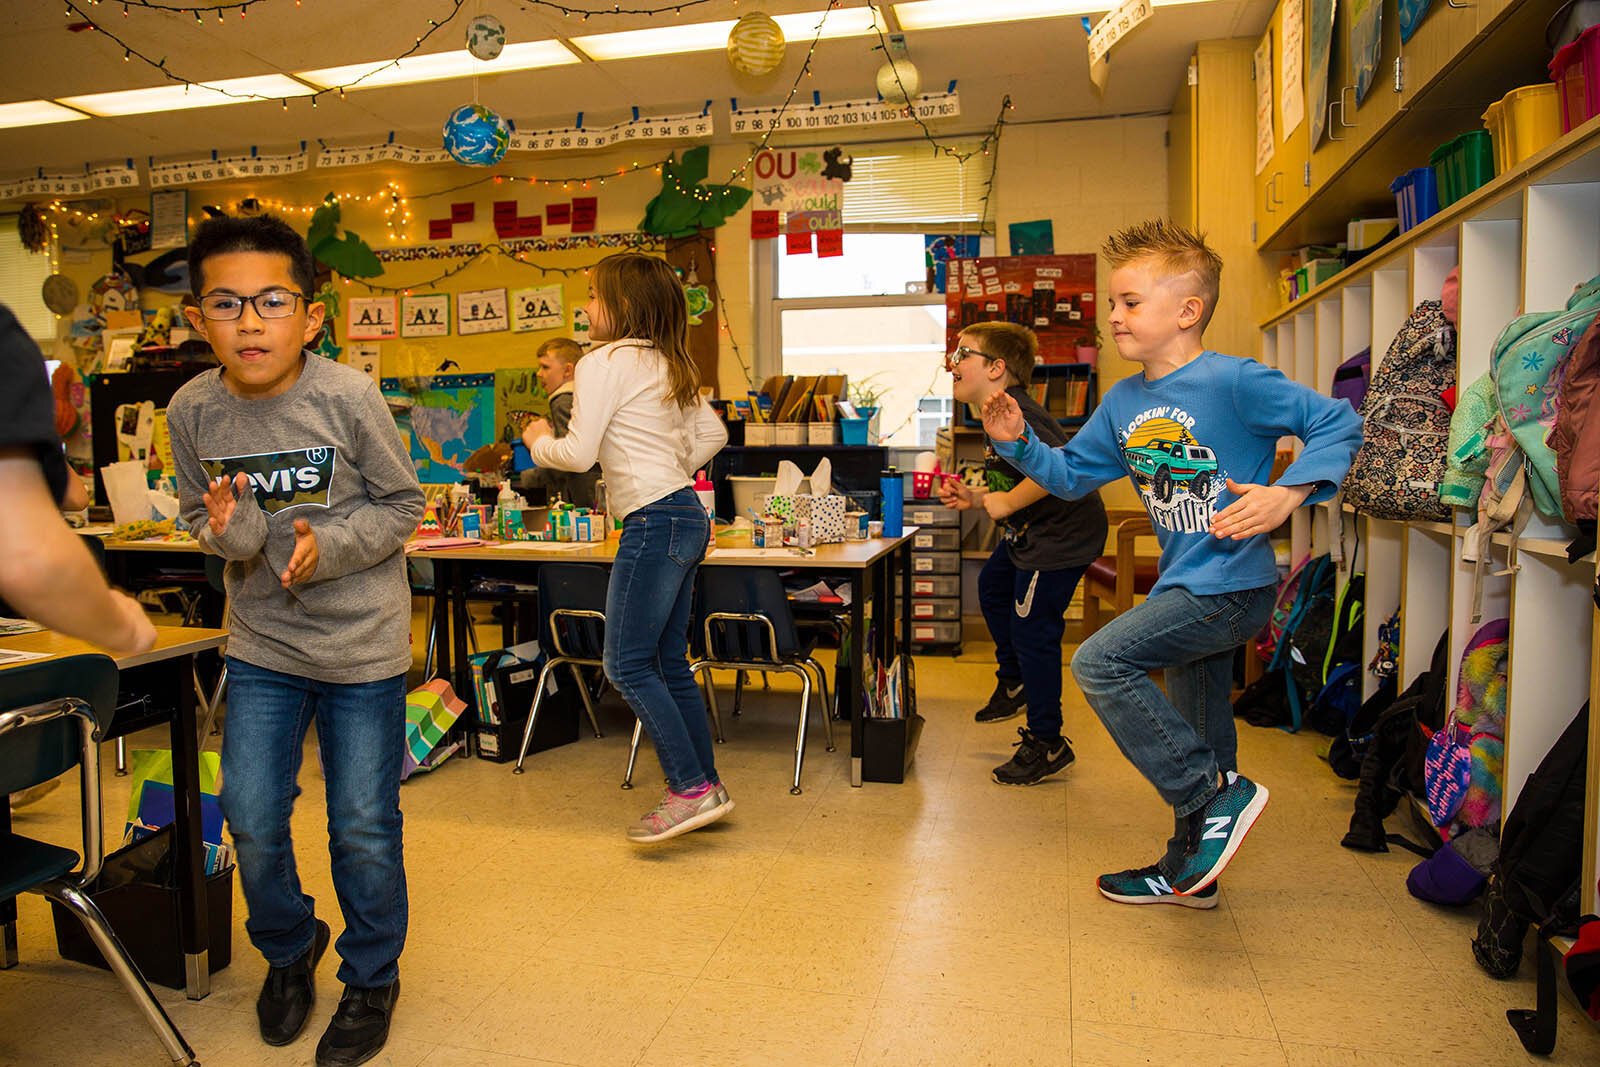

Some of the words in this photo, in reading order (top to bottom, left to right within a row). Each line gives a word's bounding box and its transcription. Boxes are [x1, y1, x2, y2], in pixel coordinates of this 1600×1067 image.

[735, 120, 746, 130] 97
[752, 119, 763, 129] 98
[787, 118, 801, 128] 100
[805, 117, 820, 127] 101
[824, 115, 839, 126] 102
[842, 114, 858, 124] 103
[861, 113, 877, 123] 104
[880, 111, 897, 121] 105
[919, 107, 935, 117] 107
[938, 104, 955, 115] 108
[527, 140, 538, 149] 86
[543, 139, 554, 148] 87
[560, 137, 571, 147] 88
[577, 137, 588, 146] 89
[595, 137, 606, 146] 90
[610, 132, 620, 141] 91
[624, 129, 636, 138] 92
[642, 127, 653, 137] 93
[659, 127, 671, 136] 94
[677, 126, 689, 136] 95
[695, 124, 706, 134] 96
[321, 157, 331, 166] 73
[336, 155, 345, 164] 74
[351, 154, 360, 163] 75
[378, 150, 388, 159] 77
[392, 150, 403, 159] 78
[409, 153, 419, 162] 79
[755, 151, 797, 179] OU
[187, 172, 198, 181] 64
[202, 170, 213, 179] 65
[253, 165, 264, 174] 69
[269, 165, 280, 174] 70
[285, 163, 292, 172] 71
[54, 183, 65, 192] 54
[1121, 405, 1170, 440] LOOKIN'
[1170, 407, 1197, 431] FOR
[1202, 815, 1232, 841] N
[1144, 875, 1174, 896] N
